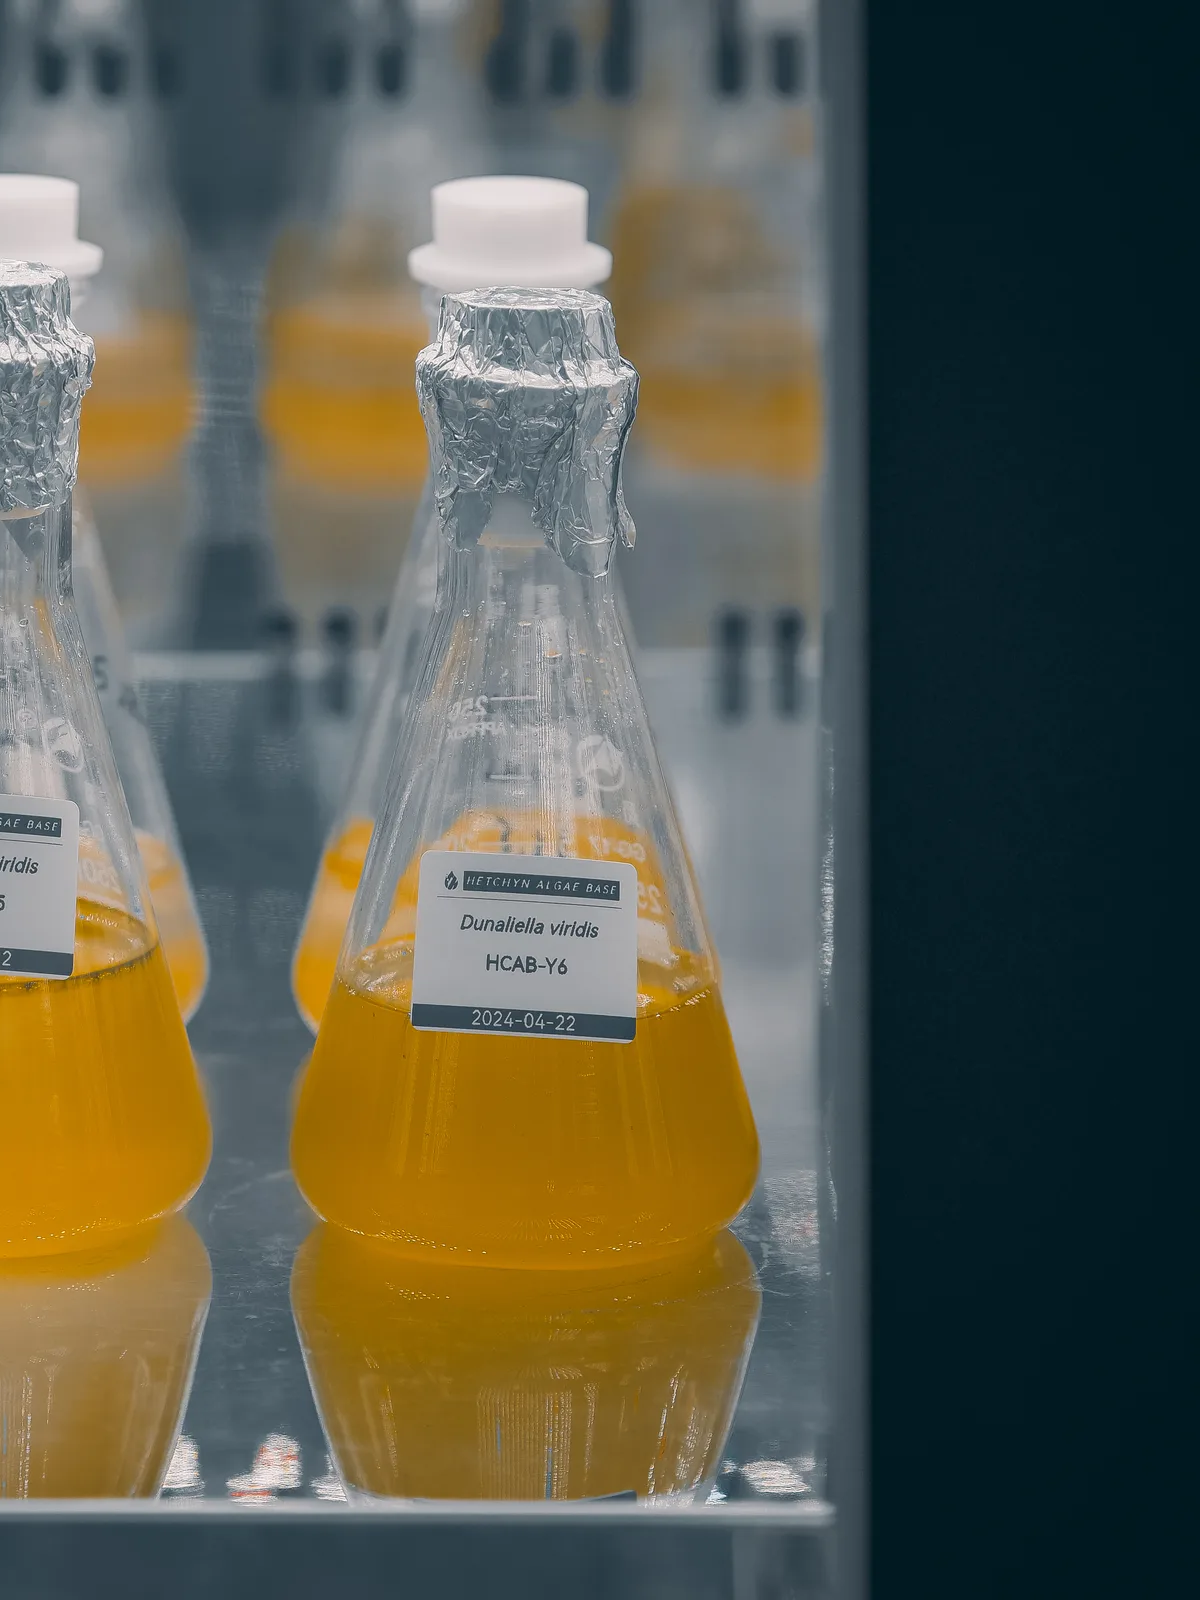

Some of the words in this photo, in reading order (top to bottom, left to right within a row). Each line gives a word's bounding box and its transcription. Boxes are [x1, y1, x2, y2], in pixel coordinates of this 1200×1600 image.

[26, 819, 59, 832] BASE
[466, 876, 531, 889] HETCHYN
[536, 880, 581, 892] ALGAE
[585, 883, 617, 895] BASE
[460, 914, 545, 935] Dunaliella
[550, 920, 600, 939] viridis
[486, 953, 568, 975] HCAB-Y6
[471, 1009, 576, 1032] 2024-04-22
